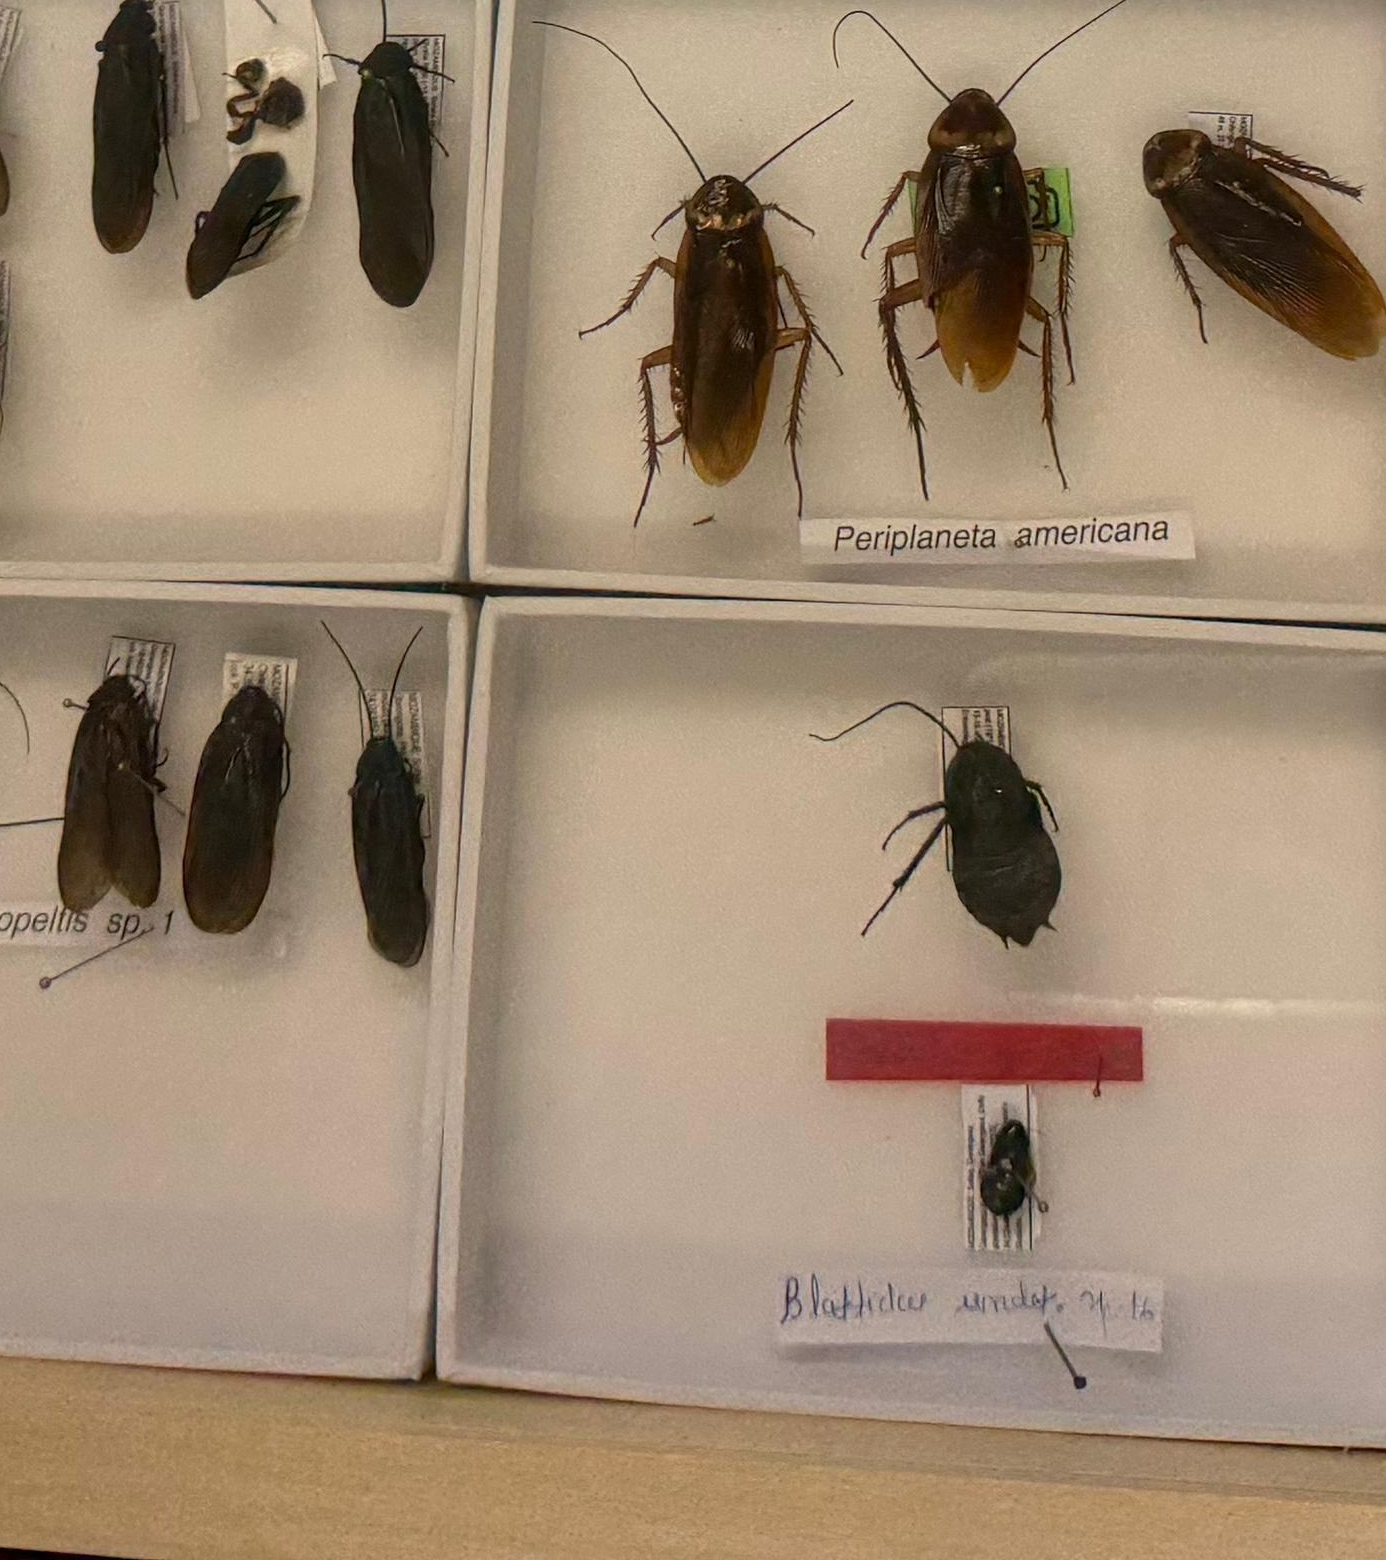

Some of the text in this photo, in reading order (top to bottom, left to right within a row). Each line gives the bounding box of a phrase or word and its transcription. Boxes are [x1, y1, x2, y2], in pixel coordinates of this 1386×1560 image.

[834, 517, 1170, 557] Periplaneta americana
[164, 910, 174, 935] 1
